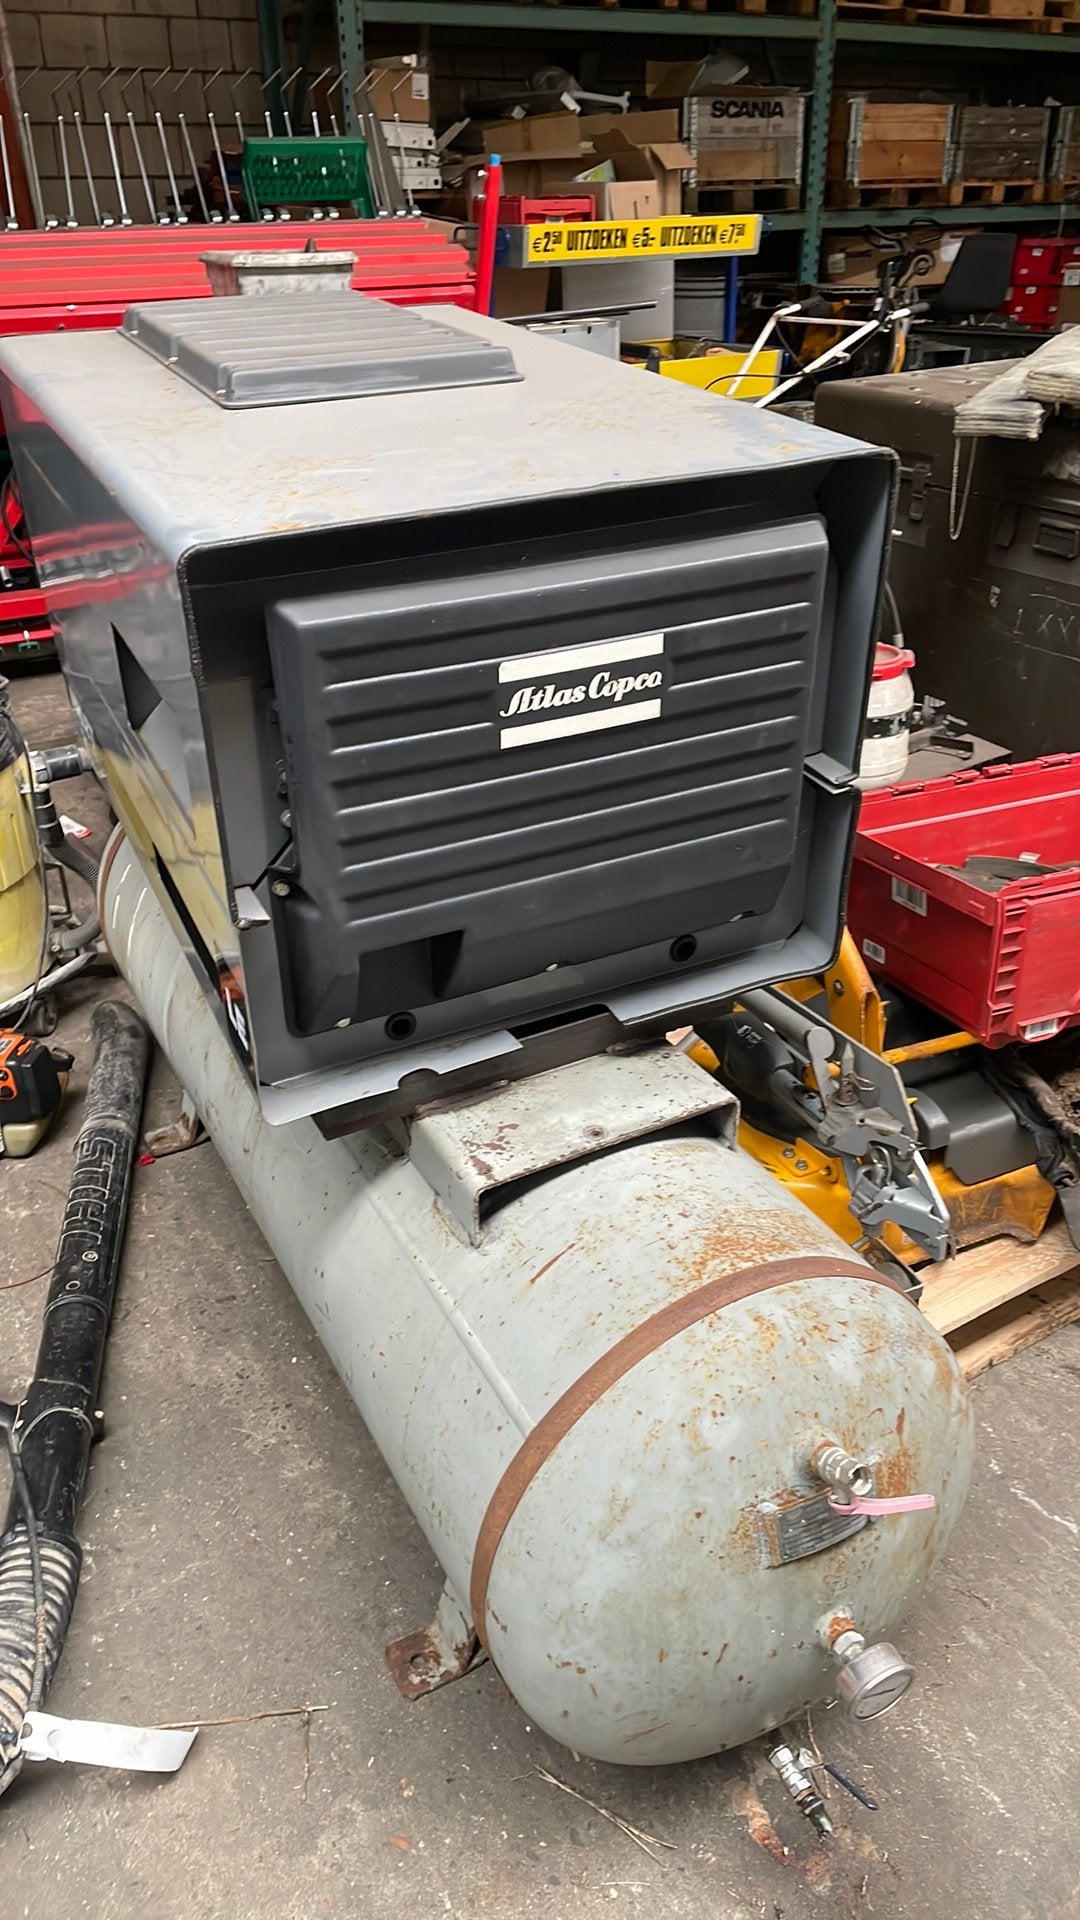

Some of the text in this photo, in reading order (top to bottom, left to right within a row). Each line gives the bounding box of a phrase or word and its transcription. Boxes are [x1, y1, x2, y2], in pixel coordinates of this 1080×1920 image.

[711, 101, 784, 118] SCANIA
[567, 228, 627, 251] UITZOEKEN
[660, 225, 718, 247] UITZOEKEN
[499, 671, 662, 717] Atlas Copco
[56, 1136, 117, 1264] STIHL
